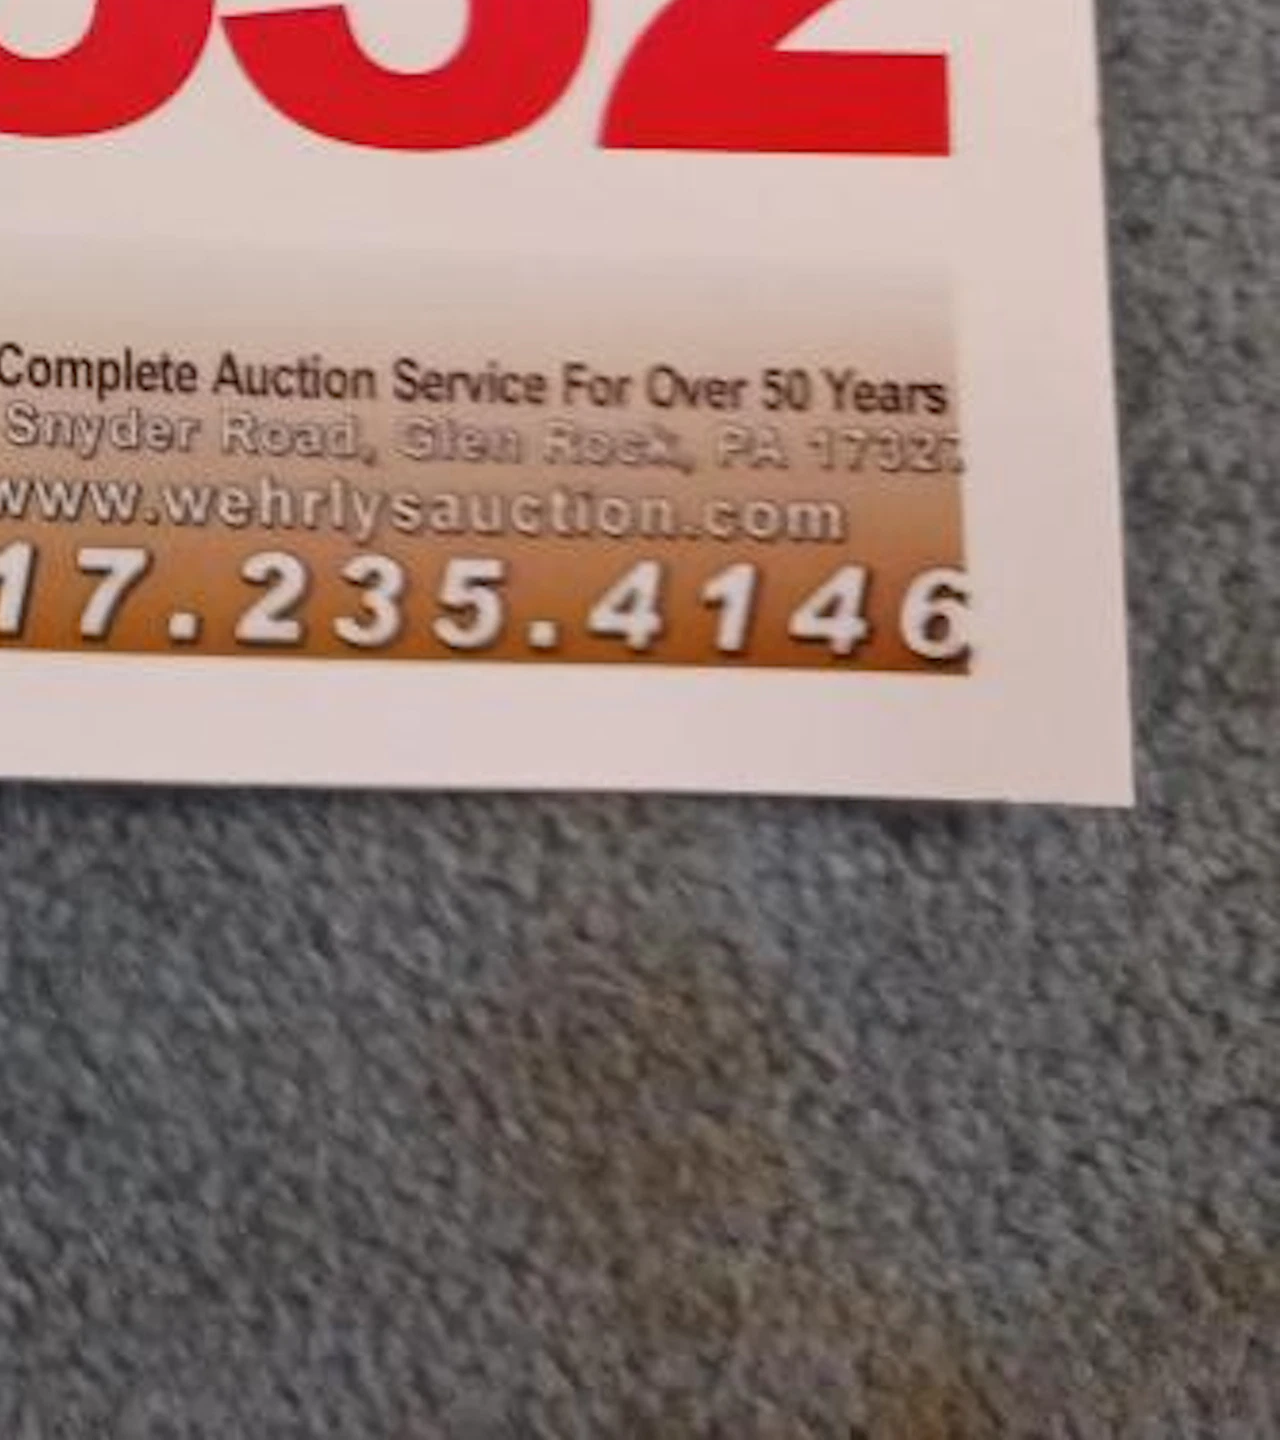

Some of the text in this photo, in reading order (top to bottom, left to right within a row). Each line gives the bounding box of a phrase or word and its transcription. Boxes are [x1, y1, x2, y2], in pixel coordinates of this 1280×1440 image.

[212, 352, 376, 400] Auction
[393, 357, 547, 405] Service
[562, 361, 632, 407] For
[646, 364, 747, 410] Over
[762, 368, 811, 411] 50
[823, 367, 948, 415] Years
[4, 399, 200, 458] Snyder
[220, 410, 378, 465] Road,
[393, 413, 521, 464] Glen
[718, 422, 790, 468] PA
